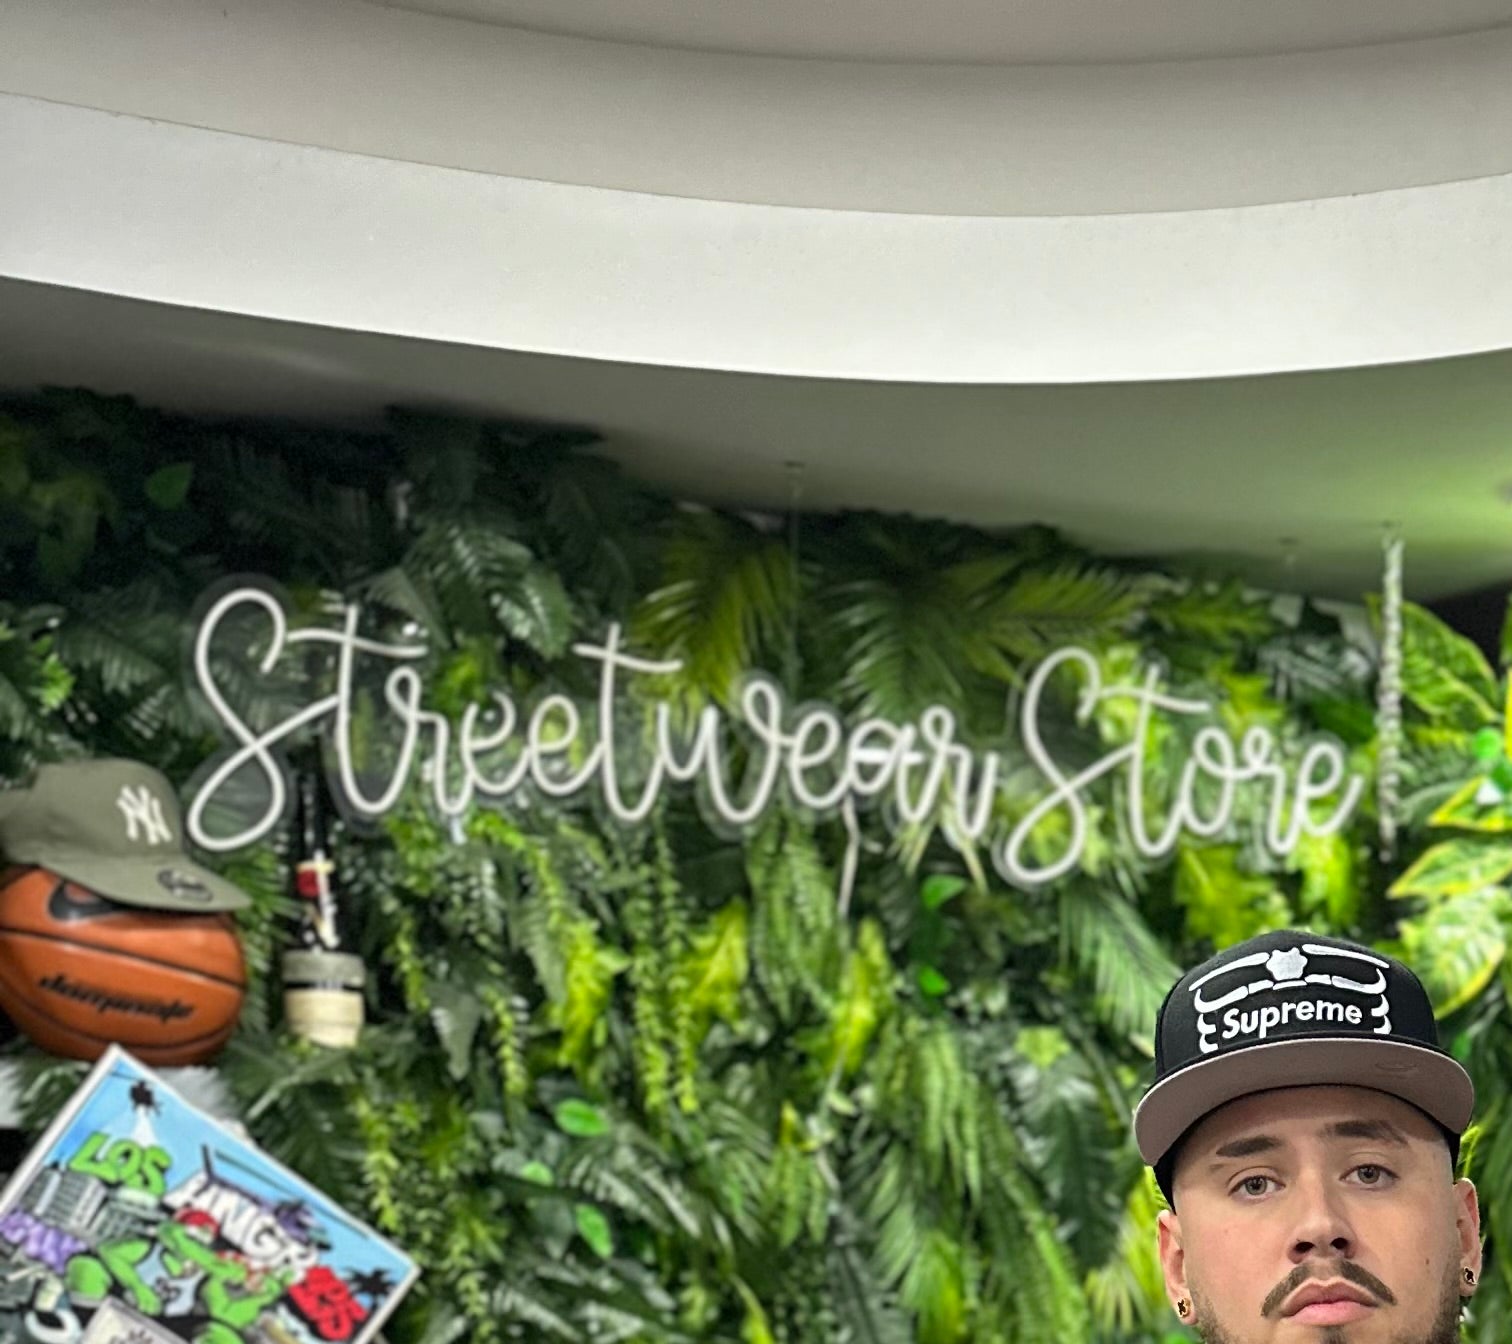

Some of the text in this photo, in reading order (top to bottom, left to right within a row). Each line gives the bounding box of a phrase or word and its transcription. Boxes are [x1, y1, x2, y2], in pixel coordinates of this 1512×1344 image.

[187, 586, 1363, 882] Streetwear Store
[1222, 999, 1363, 1039] Supreme
[69, 1131, 174, 1197] LOS
